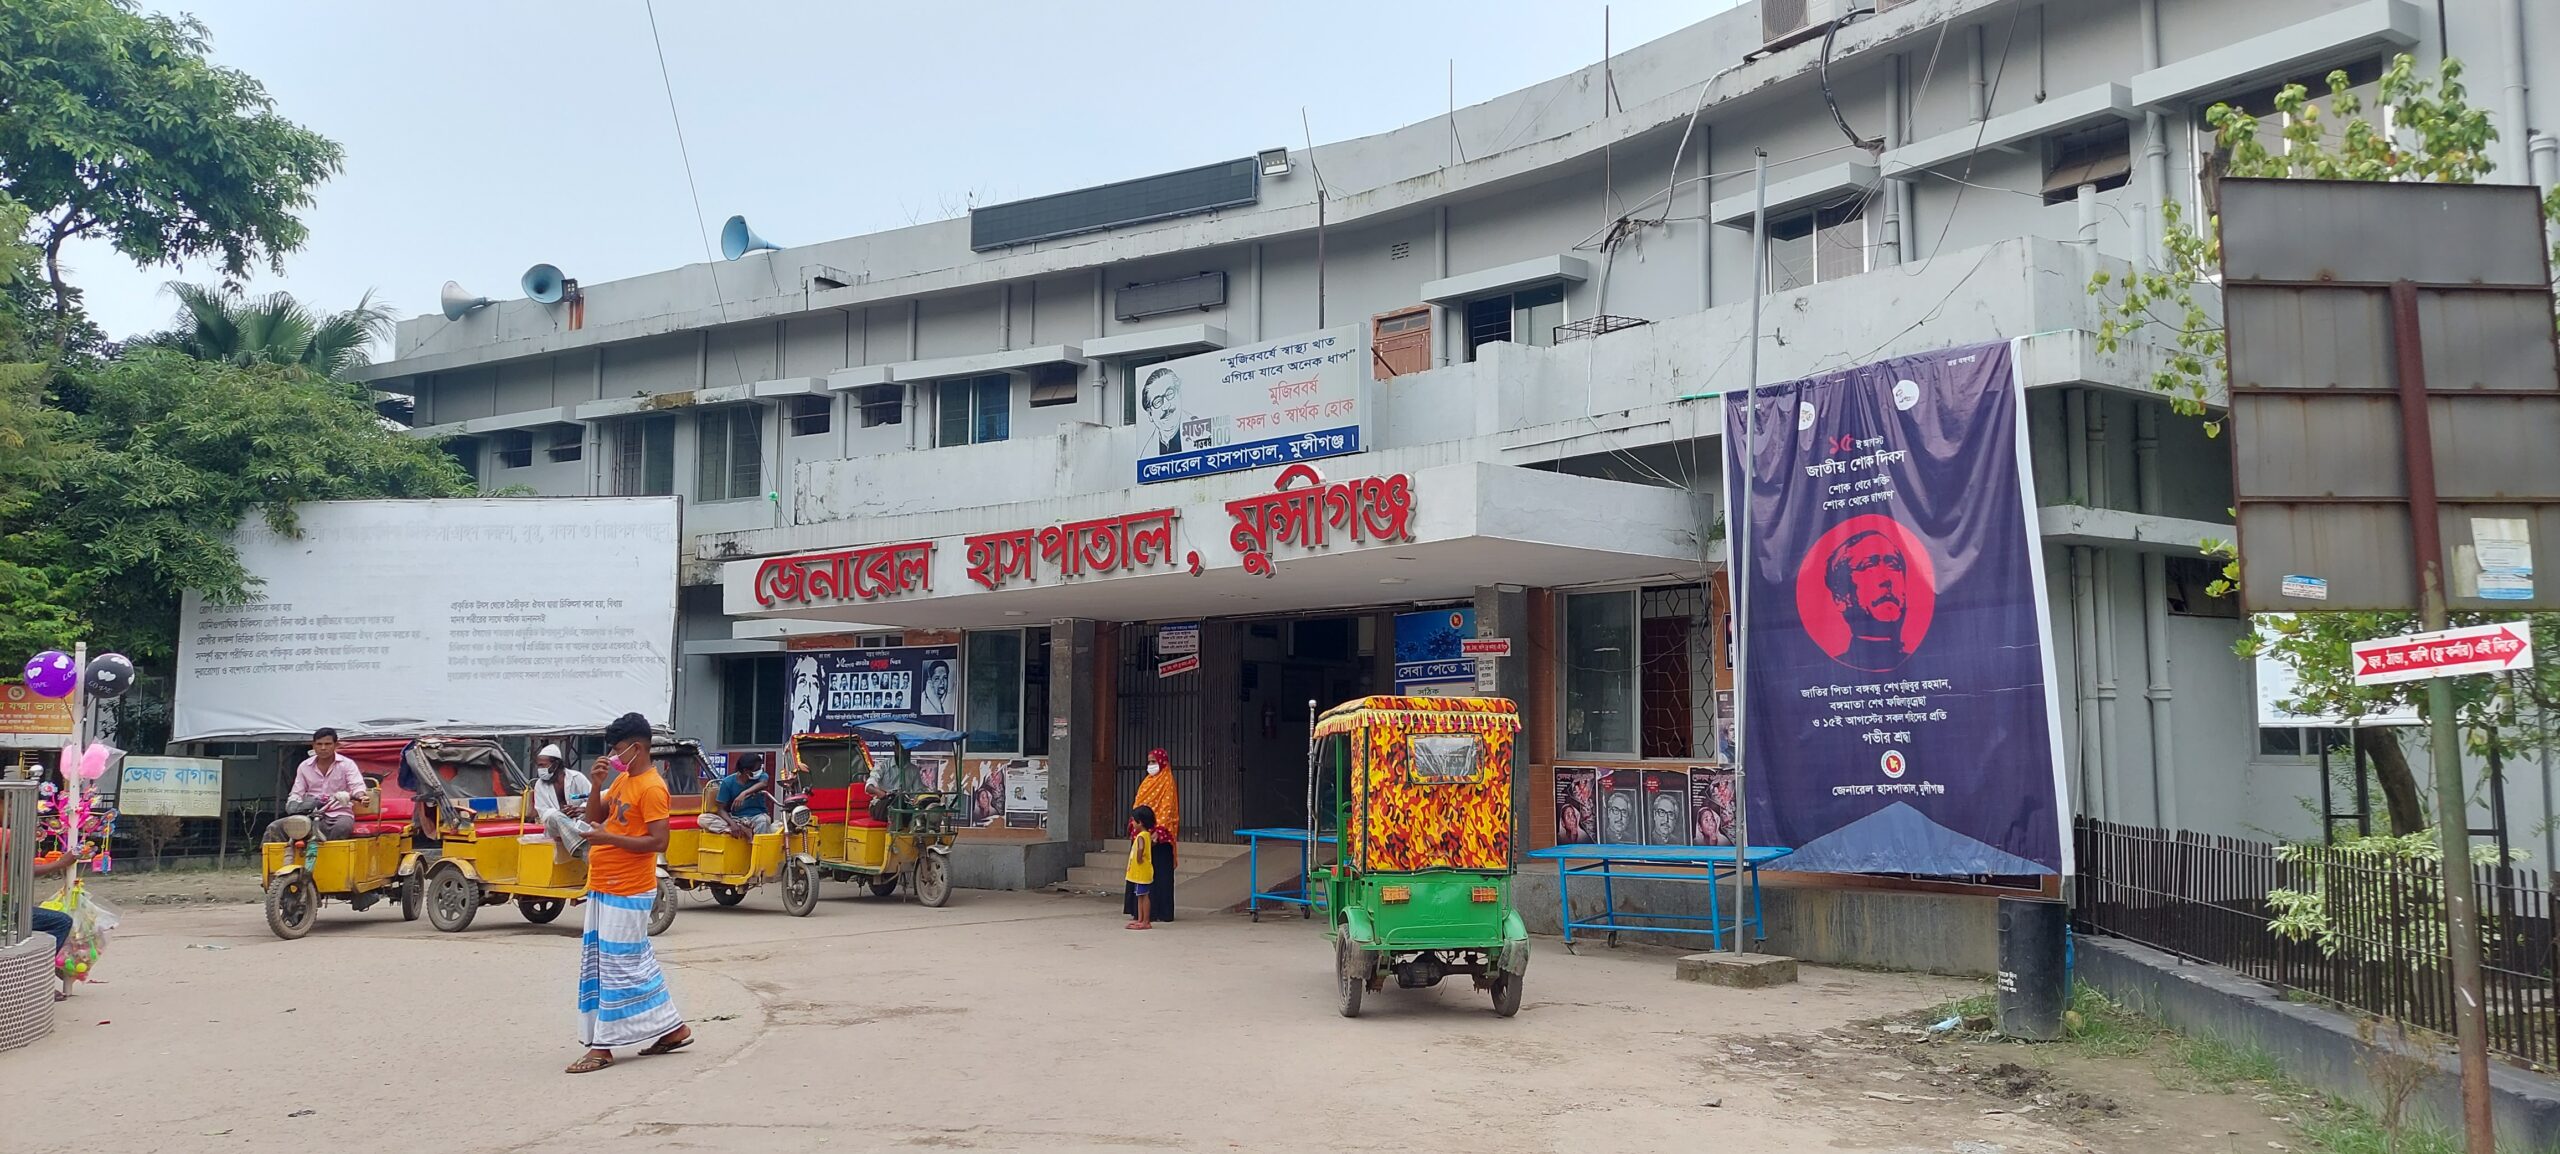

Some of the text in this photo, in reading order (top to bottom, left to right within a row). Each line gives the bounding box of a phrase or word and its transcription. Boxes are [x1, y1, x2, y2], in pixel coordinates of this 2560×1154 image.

[1220, 336, 1336, 369] “মুজিববর্ষে স্বাস্থ্য খাত
[1221, 347, 1356, 385] এগিয়ে যাবে অনেক ধাপ”
[1269, 374, 1319, 405] মুজিববর্ষ
[1236, 397, 1354, 432] সফল ও স্বার্থক হোক
[1828, 433, 1854, 455] ১৫
[1142, 455, 1201, 479] জেনারেল
[1206, 443, 1284, 469] হাসপাতাল,
[1289, 432, 1345, 460] মুন্সীগঞ্জ
[1805, 449, 1907, 479] জাতীয় শোক দিবস
[1828, 482, 1851, 495] শোক
[1823, 498, 1845, 511] শোক
[1848, 495, 1870, 507] থেকে
[754, 463, 1416, 607] জেনারেল হাসপাতাল, মুন্সীগঞ্জ
[1398, 665, 1423, 678] সেবা
[1427, 663, 1458, 675] পেতে
[1800, 686, 1829, 700] জাতির
[1830, 684, 1853, 697] পিতা
[1921, 678, 1952, 692] রহমান,
[1829, 699, 1865, 712] বঙ্গমাতা
[1867, 697, 1884, 709] শেখ
[1812, 718, 1820, 727] ও
[1844, 713, 1884, 726] আগস্টের
[1928, 708, 1948, 721] প্রতি
[1862, 728, 1891, 745] গভীর
[124, 767, 220, 785] ভেষজ বাগান
[1832, 784, 1874, 797] জেনারেল
[1876, 782, 1919, 797] হাসপাতাল,
